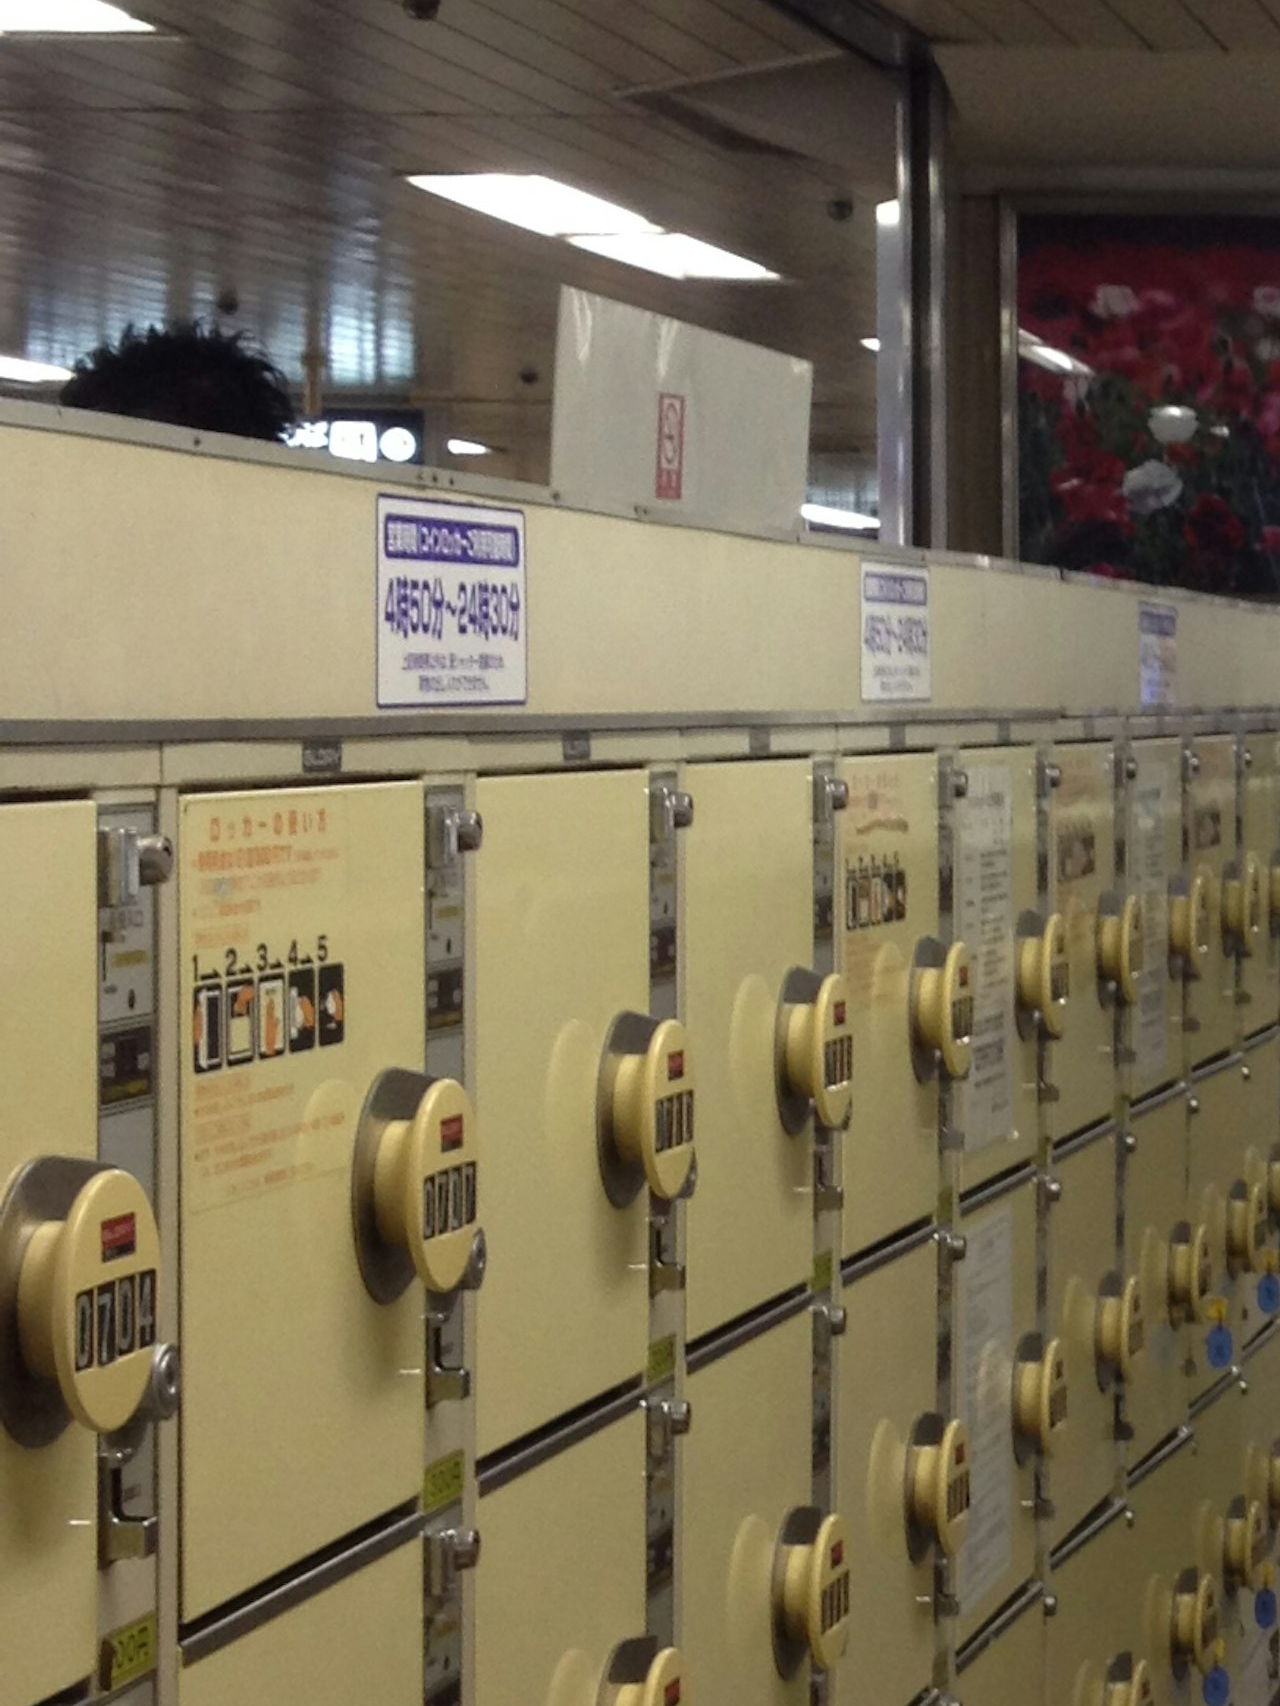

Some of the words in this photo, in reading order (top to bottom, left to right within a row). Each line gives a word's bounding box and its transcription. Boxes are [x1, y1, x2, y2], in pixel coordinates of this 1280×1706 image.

[192, 954, 199, 982] 1
[225, 948, 238, 976] 2
[256, 943, 268, 971] 3
[288, 939, 298, 966] 4
[317, 934, 328, 962] 5
[76, 1274, 155, 1369] 0704
